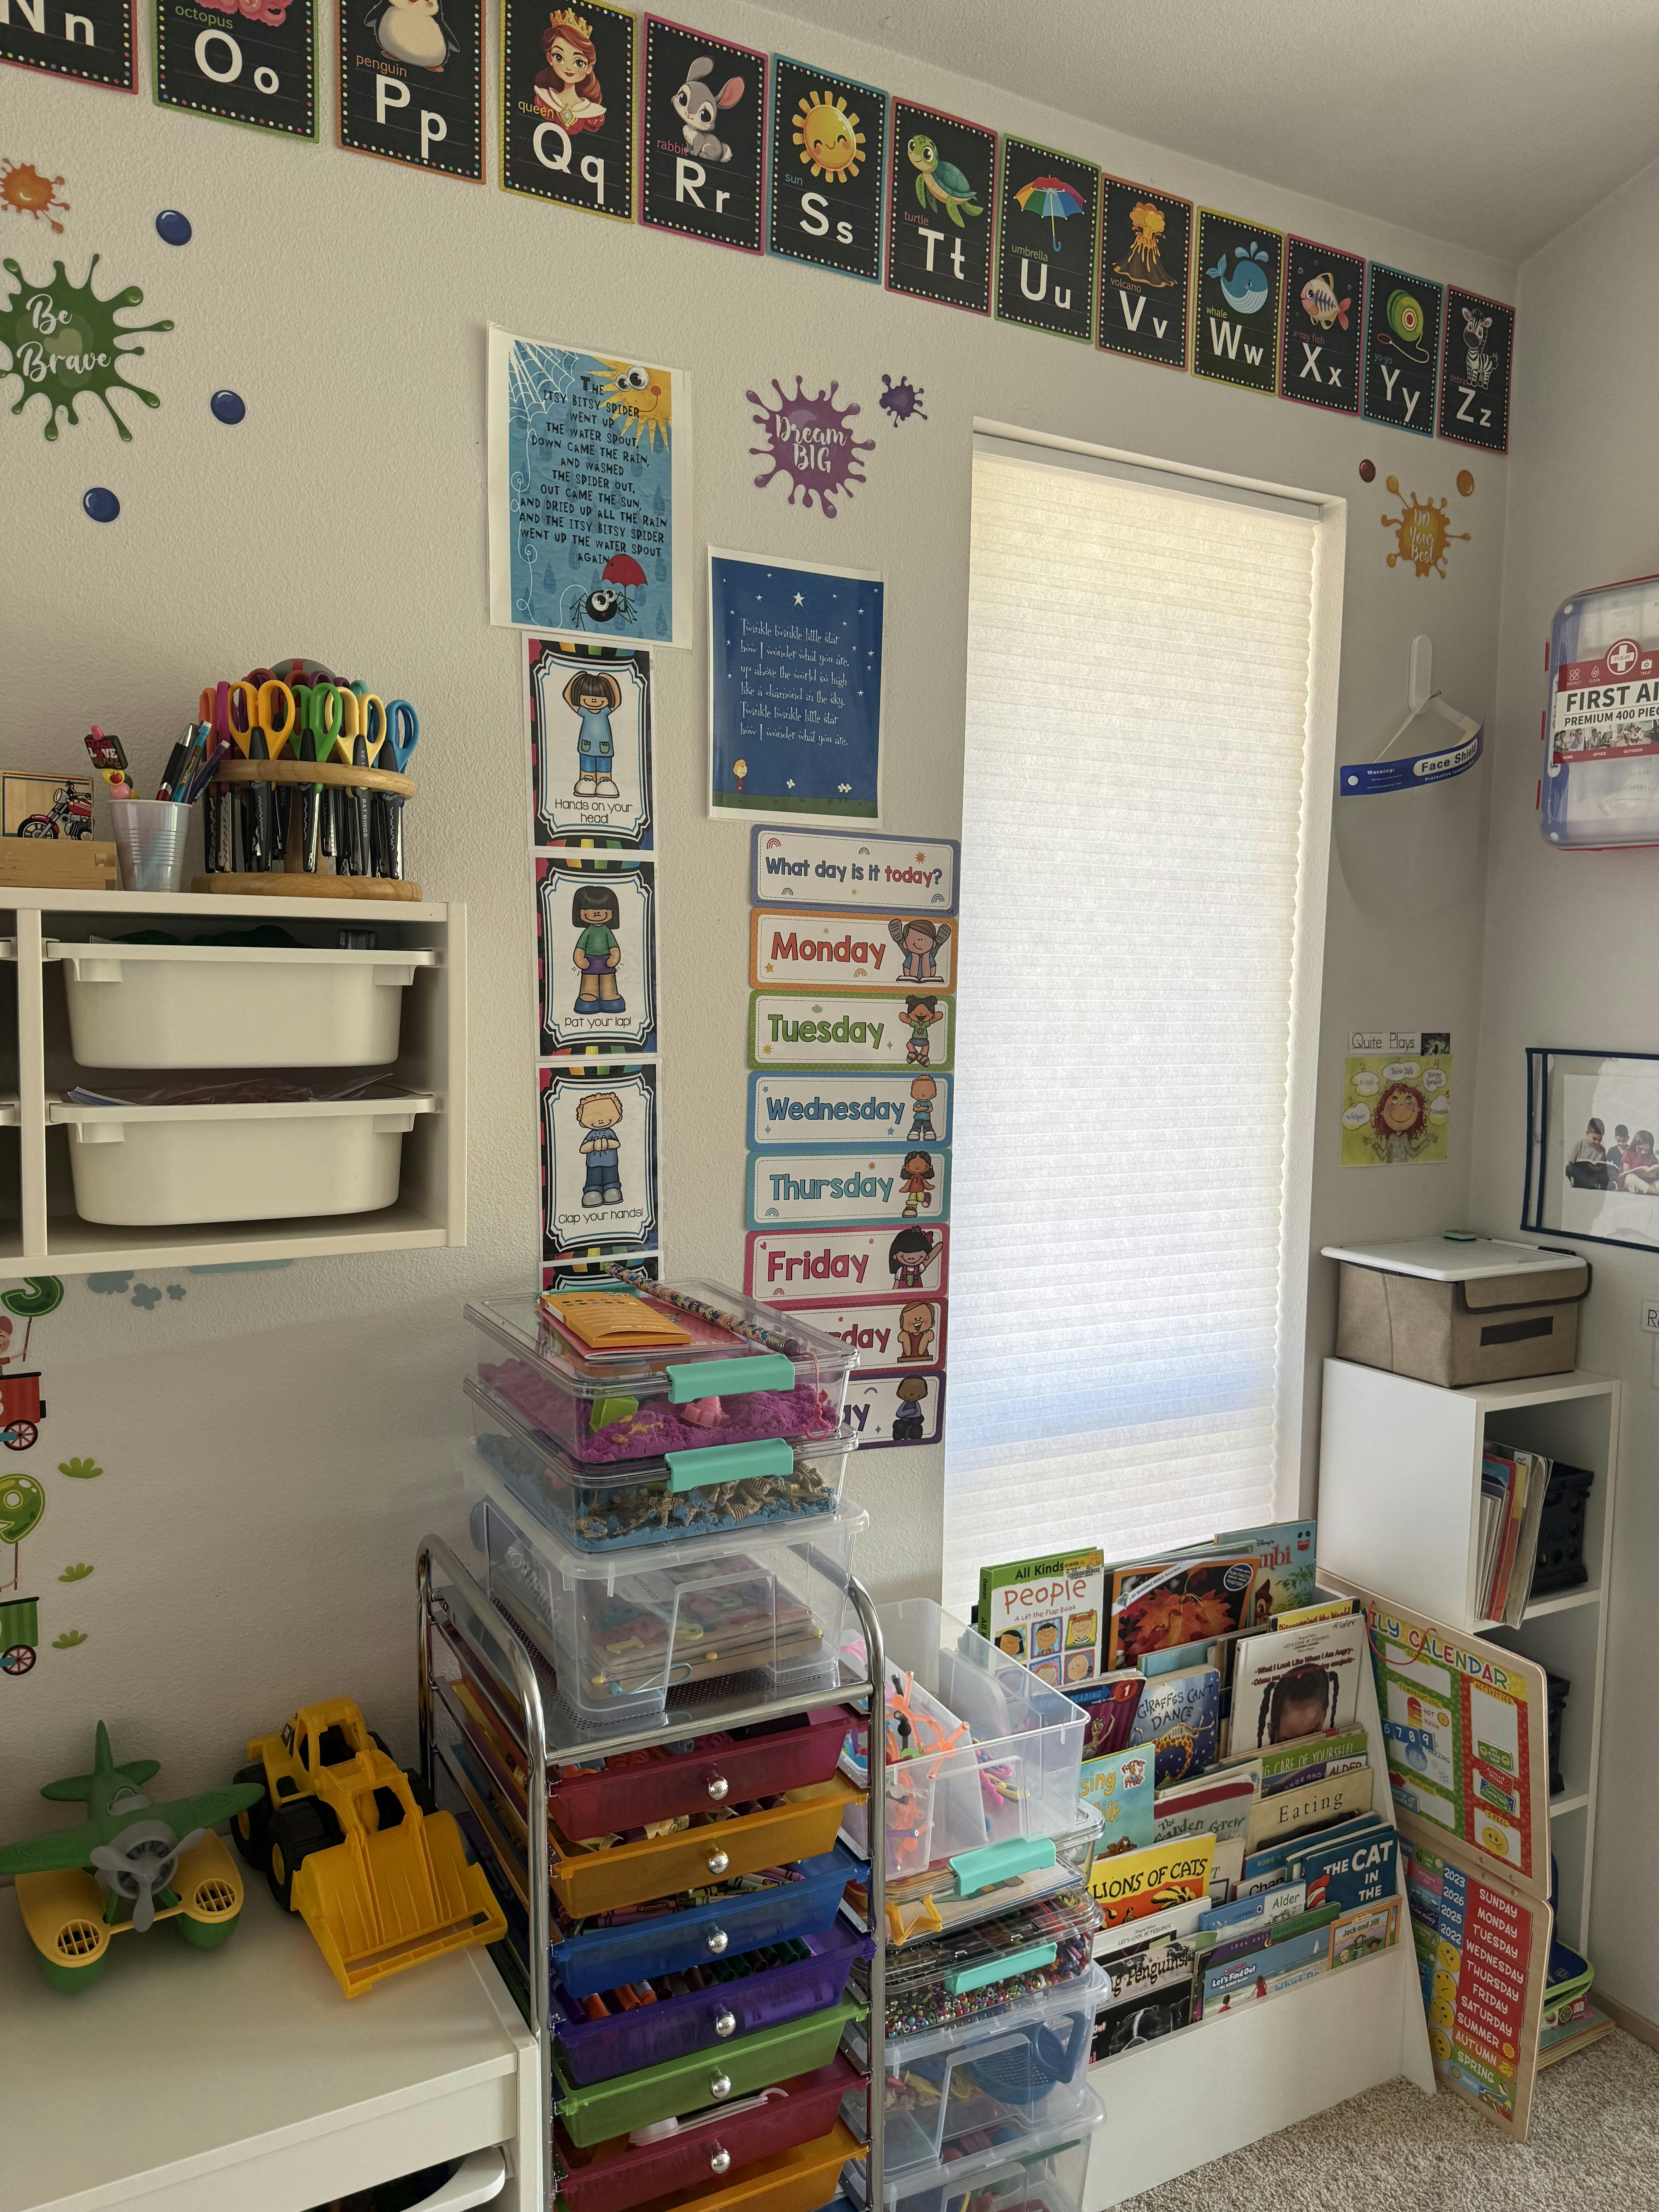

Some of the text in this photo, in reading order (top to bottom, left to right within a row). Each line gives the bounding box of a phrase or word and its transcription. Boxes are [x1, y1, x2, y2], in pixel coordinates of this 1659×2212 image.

[175, 5, 234, 29] octopus
[194, 29, 279, 94] Oo
[356, 54, 407, 78] penguin
[376, 74, 447, 159] Pp
[518, 99, 555, 119] queen
[657, 139, 689, 156] rabbit
[533, 122, 604, 204] Qq
[676, 157, 730, 213] Rr
[785, 173, 803, 187] sun
[799, 192, 853, 244] Ss
[904, 211, 929, 226] turtle
[918, 227, 965, 280] Tt
[1012, 242, 1049, 262] umbrella
[1020, 258, 1071, 310] Uu
[1110, 277, 1142, 293] volcano
[26, 293, 72, 335] Be
[1119, 289, 1168, 339] Vv
[1206, 306, 1228, 319] whale
[1210, 317, 1264, 366] Ww
[1293, 330, 1325, 345] x-ray fish
[17, 341, 111, 382] Brave
[1299, 342, 1343, 388] Xx
[1374, 352, 1393, 366] yo-yo
[580, 375, 604, 395] THE
[1380, 364, 1420, 423] Yy
[1449, 374, 1466, 385] zebra
[543, 390, 640, 418] ITSY BITSY SPIDER
[1456, 386, 1492, 428] Zz
[570, 412, 614, 428] WENT UP
[776, 414, 847, 447] Dream
[546, 422, 639, 449] THE WATER SPOUT.
[532, 434, 650, 468] DOWN CAME THE RAIN,
[793, 443, 831, 473] BIG
[561, 457, 624, 476] AND WASHED
[552, 469, 635, 494] THE SPIDER OUT.
[541, 484, 642, 512] OUT CAME THE SUN,
[520, 498, 667, 527] AND DRIED UP ALL THE RAIN
[740, 618, 840, 644] Twinkle twinkle little star
[740, 640, 757, 653] how
[760, 642, 763, 659] I
[767, 645, 797, 659] wonder
[799, 649, 816, 662] what
[819, 655, 833, 666] you
[1566, 685, 1630, 712] FIRST
[1565, 709, 1635, 726] PREMIUM 400
[1422, 742, 1477, 773] Face Shield
[555, 799, 633, 814] Hands on your
[765, 856, 943, 888] What day is it today?
[771, 931, 886, 970] Monday
[587, 1018, 613, 1029] your
[768, 1014, 884, 1049] Tuesday
[1352, 1032, 1415, 1052] Quite Plays
[766, 1097, 905, 1125] Wednesday
[769, 1172, 894, 1203] Thursday
[558, 1214, 580, 1225] Clap
[583, 1212, 608, 1224] your
[767, 1249, 869, 1283] Friday
[1015, 1565, 1030, 1581] All
[1034, 1561, 1064, 1577] Kinds
[1060, 1604, 1076, 1614] Book
[1409, 1630, 1508, 1690] CALENDAR
[1137, 1683, 1214, 1719] GIRAFFES CAN'T
[1151, 1706, 1193, 1731] DANCE
[1278, 1792, 1344, 1824] Eating
[1323, 1858, 1348, 1876] THE
[1352, 1839, 1393, 1872] CAT
[1147, 1858, 1208, 1887] OF CATS
[1364, 1869, 1379, 1884] IN
[1444, 1867, 1465, 1887] 2023
[1273, 1894, 1300, 1910] Alder
[1358, 1885, 1382, 1902] THE
[1443, 1886, 1464, 1906] 2026
[1479, 1889, 1518, 1918] SUNDAY
[1441, 1905, 1462, 1924] 2025
[1477, 1906, 1518, 1939] MONDAY
[1343, 1927, 1356, 1937] Jack
[1356, 1922, 1369, 1932] and
[1440, 1923, 1462, 1945] 2022
[1472, 1924, 1518, 1959] TUESDAY
[1466, 1939, 1524, 1984] WEDNESDAY
[1212, 1964, 1256, 1988] Let's Find Out
[1466, 1960, 1519, 2002] THURSDAY
[1472, 1983, 1508, 2014] FRIDAY
[1457, 2012, 1500, 2049] SUMMER
[1461, 1996, 1513, 2037] SATURDAY
[1455, 2030, 1498, 2066] AUTUMN
[1457, 2050, 1495, 2083] SPRING
